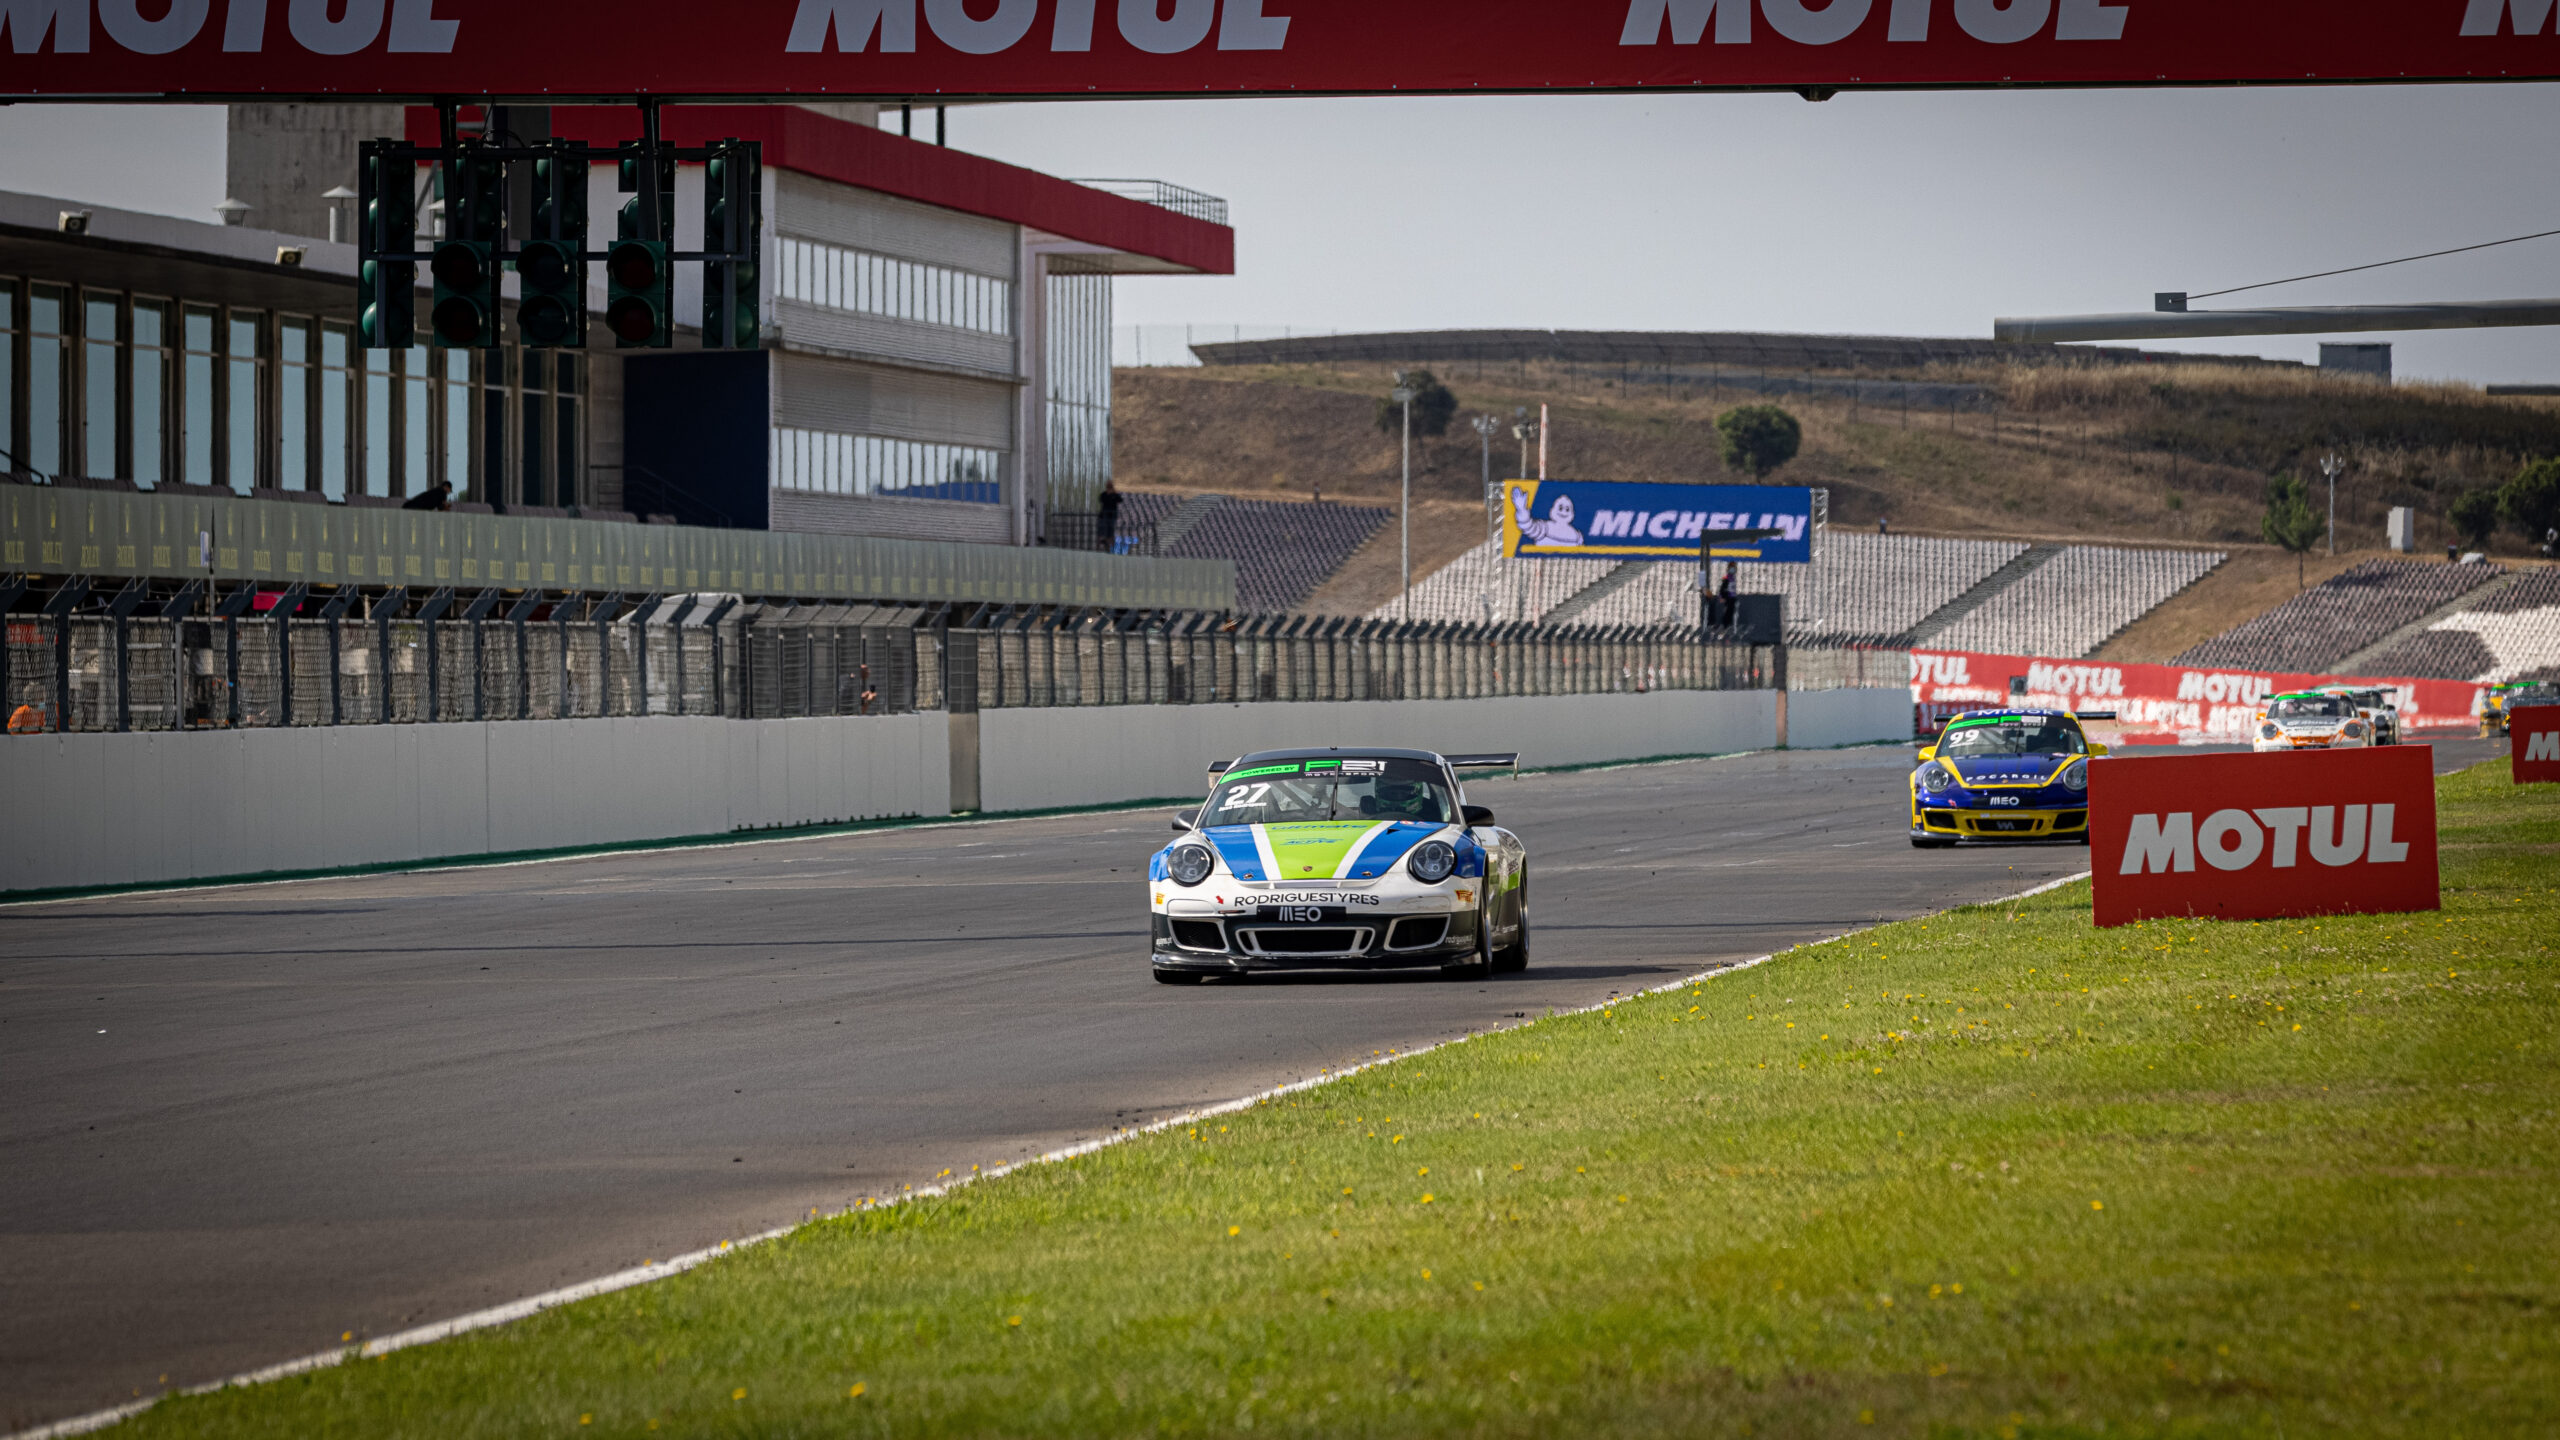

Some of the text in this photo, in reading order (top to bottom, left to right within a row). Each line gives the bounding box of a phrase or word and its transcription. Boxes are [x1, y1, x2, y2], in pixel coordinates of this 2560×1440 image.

[2026, 660, 2126, 697] MOTUL
[1949, 729, 1980, 746] 99
[1241, 767, 1282, 776] POWERED
[1225, 783, 1272, 806] 27
[1989, 796, 2020, 806] MEO
[2119, 803, 2410, 875] MOTUL
[1234, 892, 1380, 907] RODRIGUESTYRES
[1278, 906, 1322, 922] MEO
